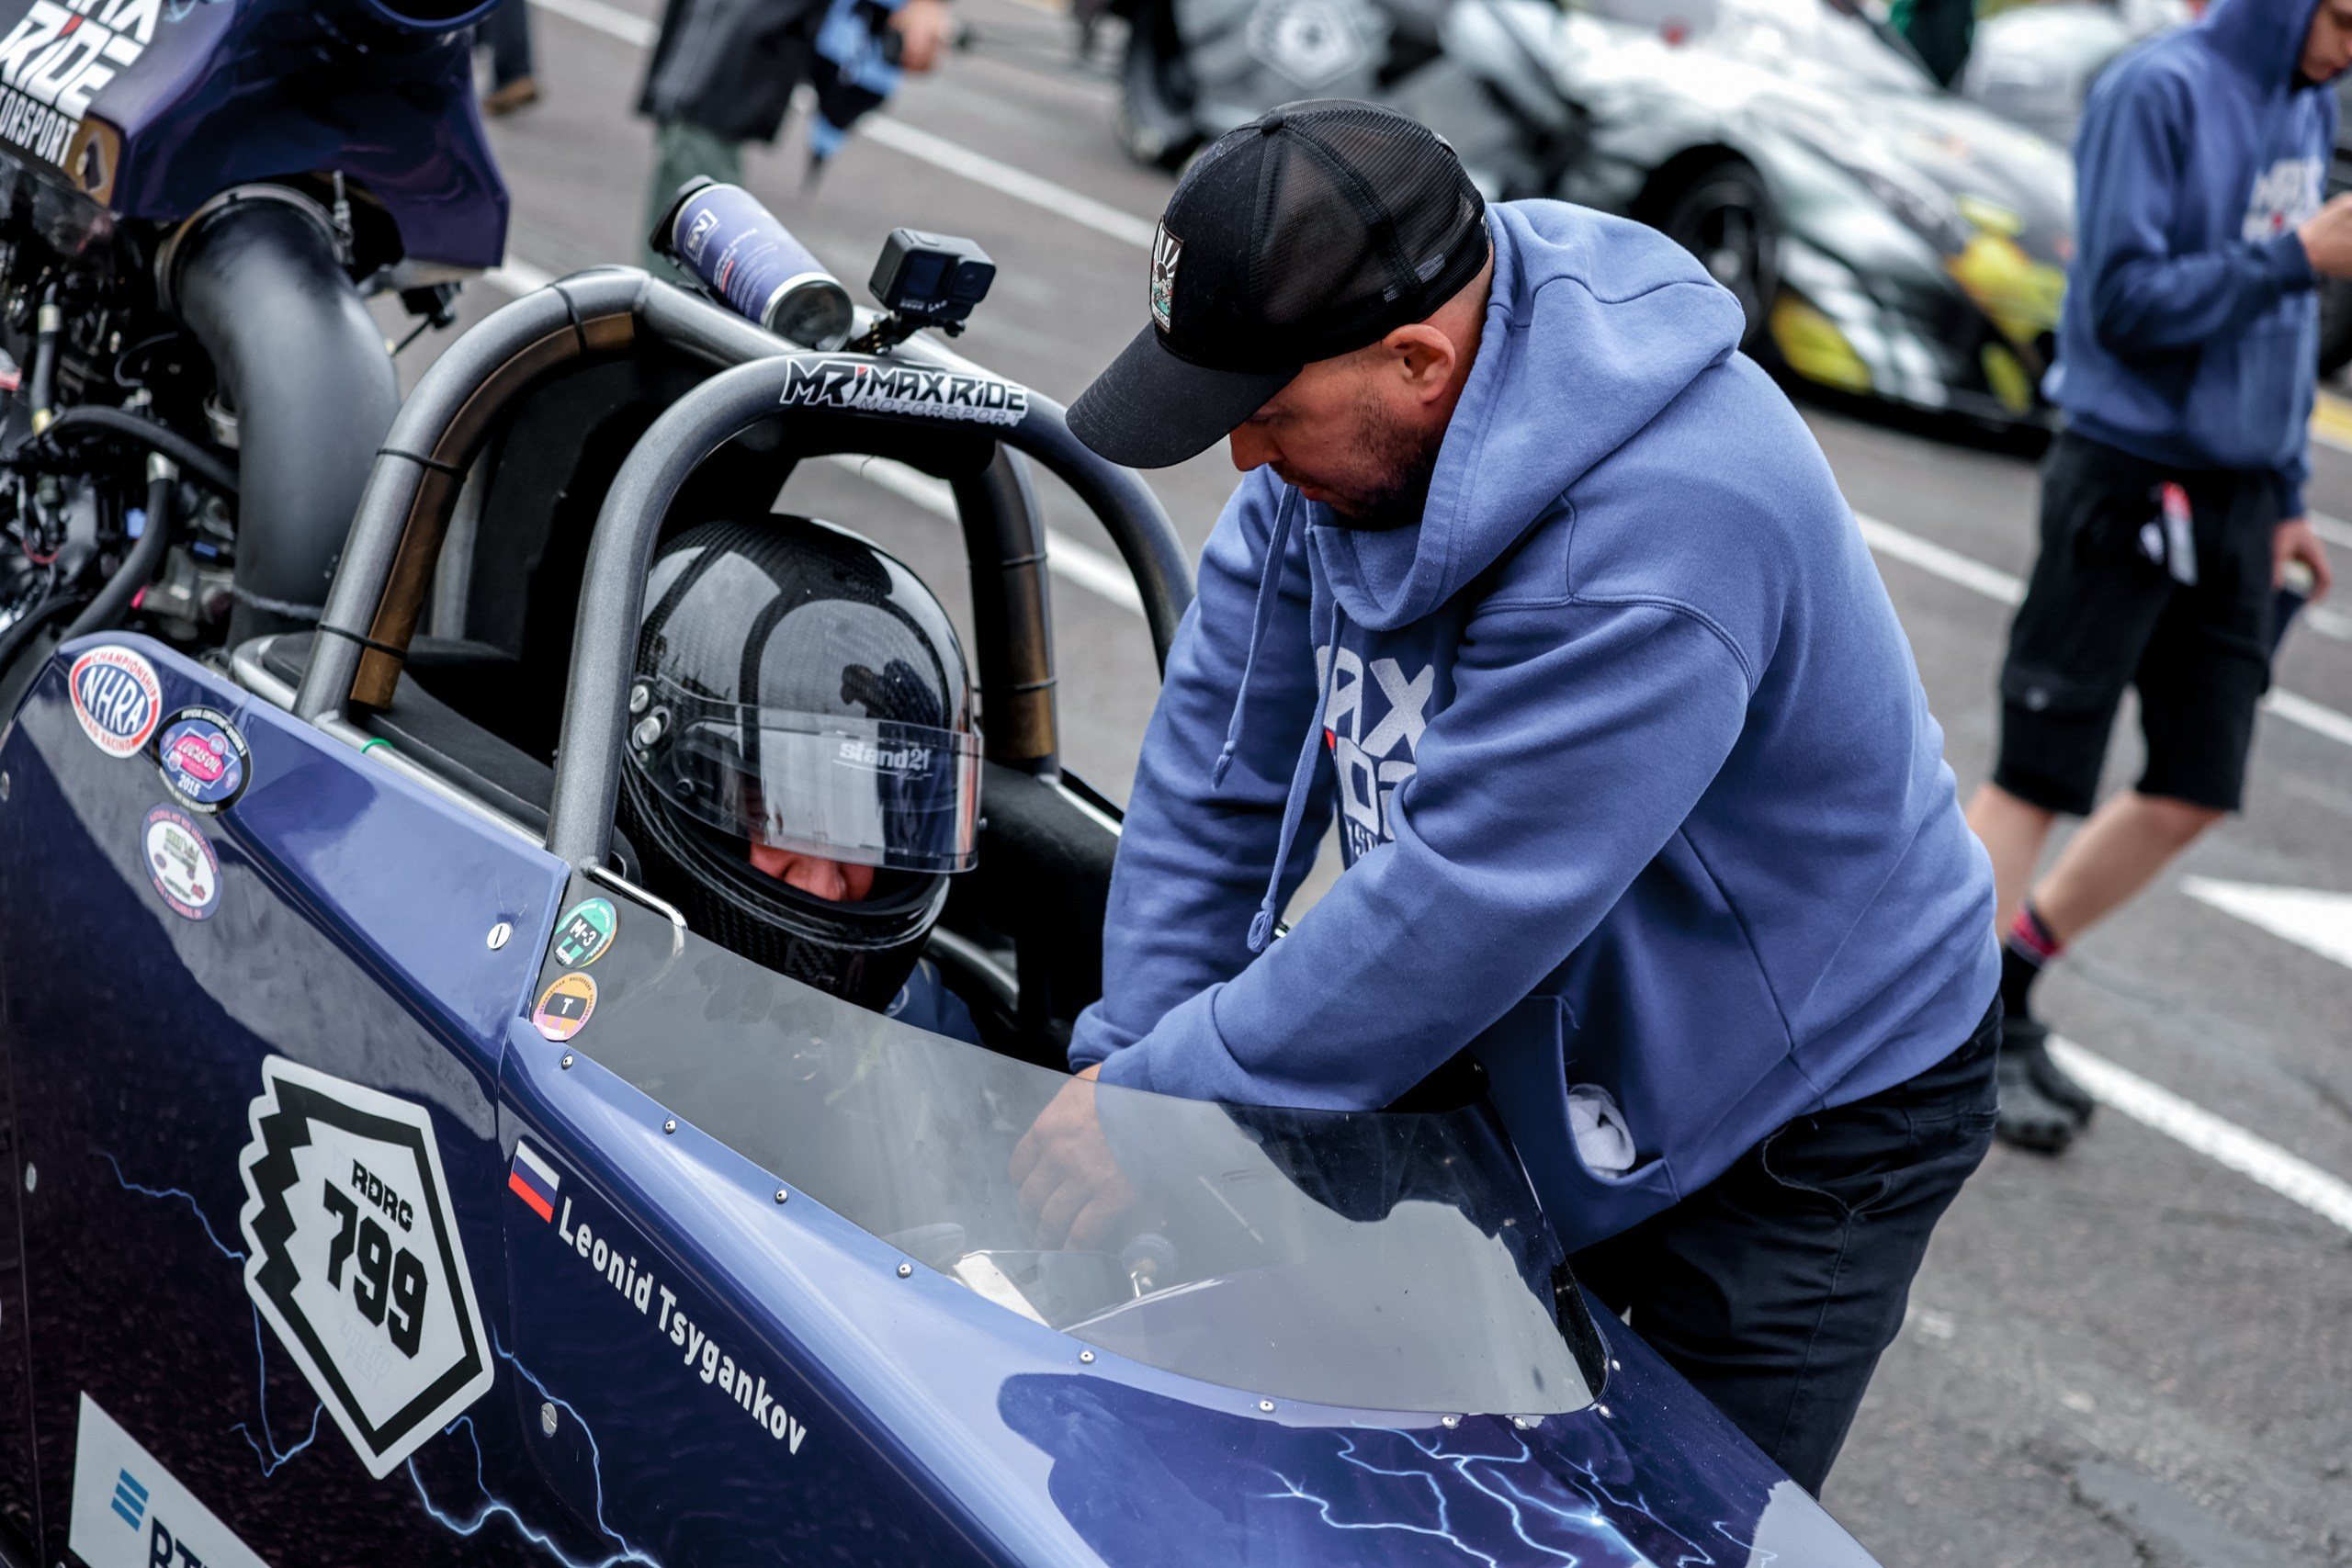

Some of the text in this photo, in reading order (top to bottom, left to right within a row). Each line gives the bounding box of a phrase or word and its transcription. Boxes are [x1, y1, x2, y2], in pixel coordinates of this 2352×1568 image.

[858, 397, 1024, 427] MOTORSPORT
[82, 665, 146, 735] NHRA
[92, 651, 157, 698] CHAMPIONSHIP
[1317, 645, 1435, 759] AX
[79, 705, 132, 751] DRAG RACING
[177, 739, 209, 764] LUCAS
[204, 758, 221, 773] OIL
[177, 773, 201, 797] 2015
[351, 1158, 413, 1233] RDRC
[323, 1178, 428, 1359] 799
[559, 1196, 807, 1455] Leonid Tsygankov
